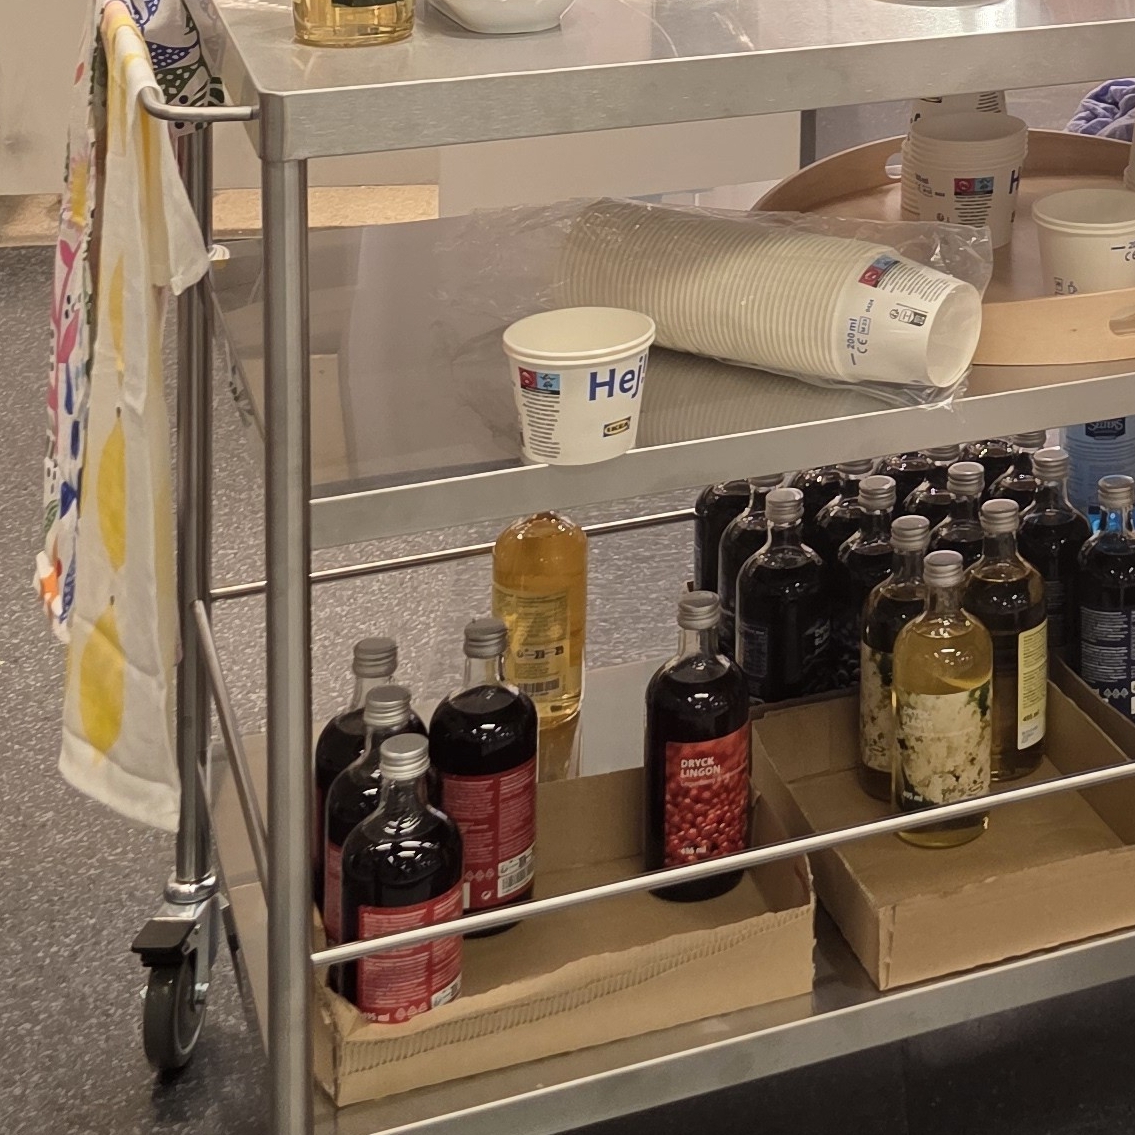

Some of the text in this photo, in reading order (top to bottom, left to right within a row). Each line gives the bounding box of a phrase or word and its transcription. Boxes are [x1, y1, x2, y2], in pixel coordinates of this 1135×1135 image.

[846, 318, 858, 350] 200 ml
[588, 353, 648, 402] Hej!
[680, 757, 714, 767] DRYCK
[680, 765, 720, 779] LINGON
